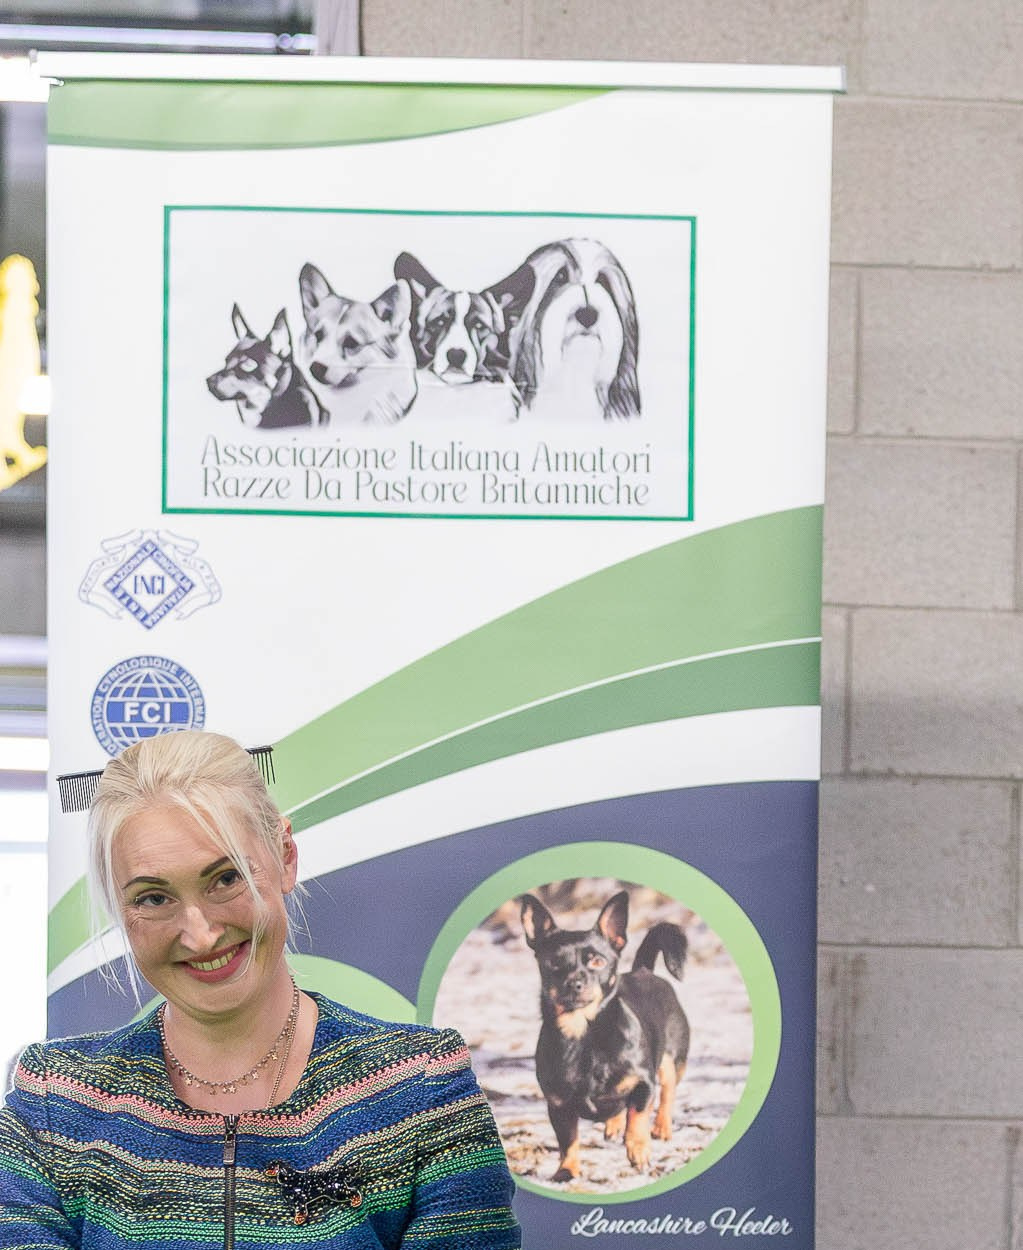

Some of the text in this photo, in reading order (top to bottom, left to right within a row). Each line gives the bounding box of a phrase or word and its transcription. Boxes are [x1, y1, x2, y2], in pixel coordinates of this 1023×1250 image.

[201, 434, 651, 474] Associazione Italiana Amatori
[203, 466, 650, 505] Razze Da Pastore Britanniche
[124, 702, 171, 723] FCI
[570, 1206, 794, 1237] Lancashire Heeler
